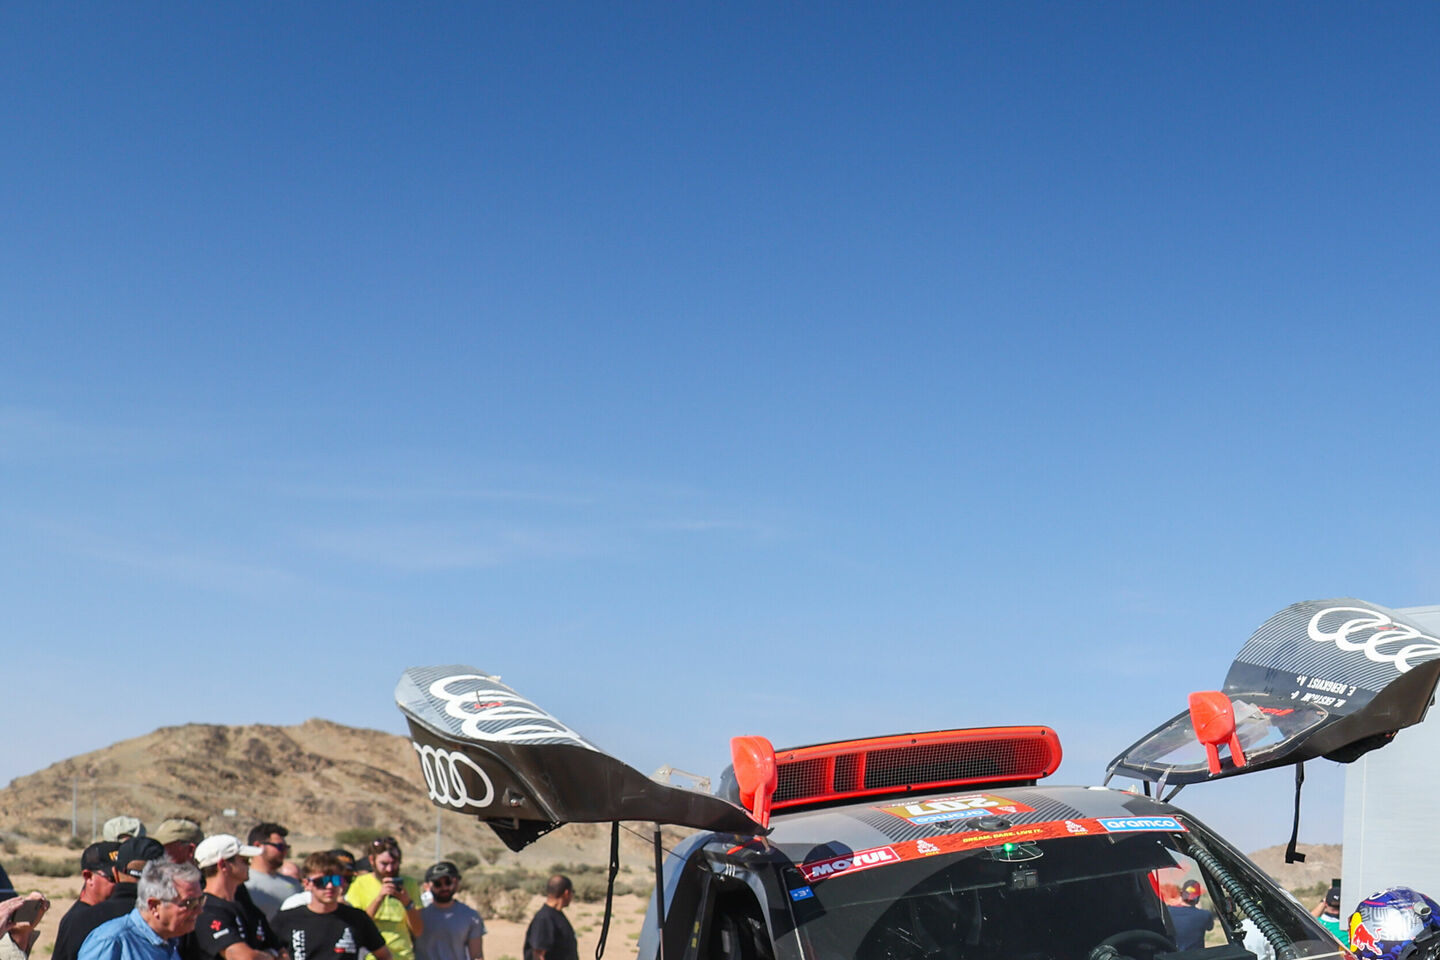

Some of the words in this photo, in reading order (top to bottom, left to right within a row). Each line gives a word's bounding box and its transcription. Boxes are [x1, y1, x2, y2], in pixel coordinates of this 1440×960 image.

[905, 798, 999, 815] 207
[916, 810, 984, 822] aramco
[1106, 820, 1175, 829] aramco
[812, 848, 893, 877] MOTUL
